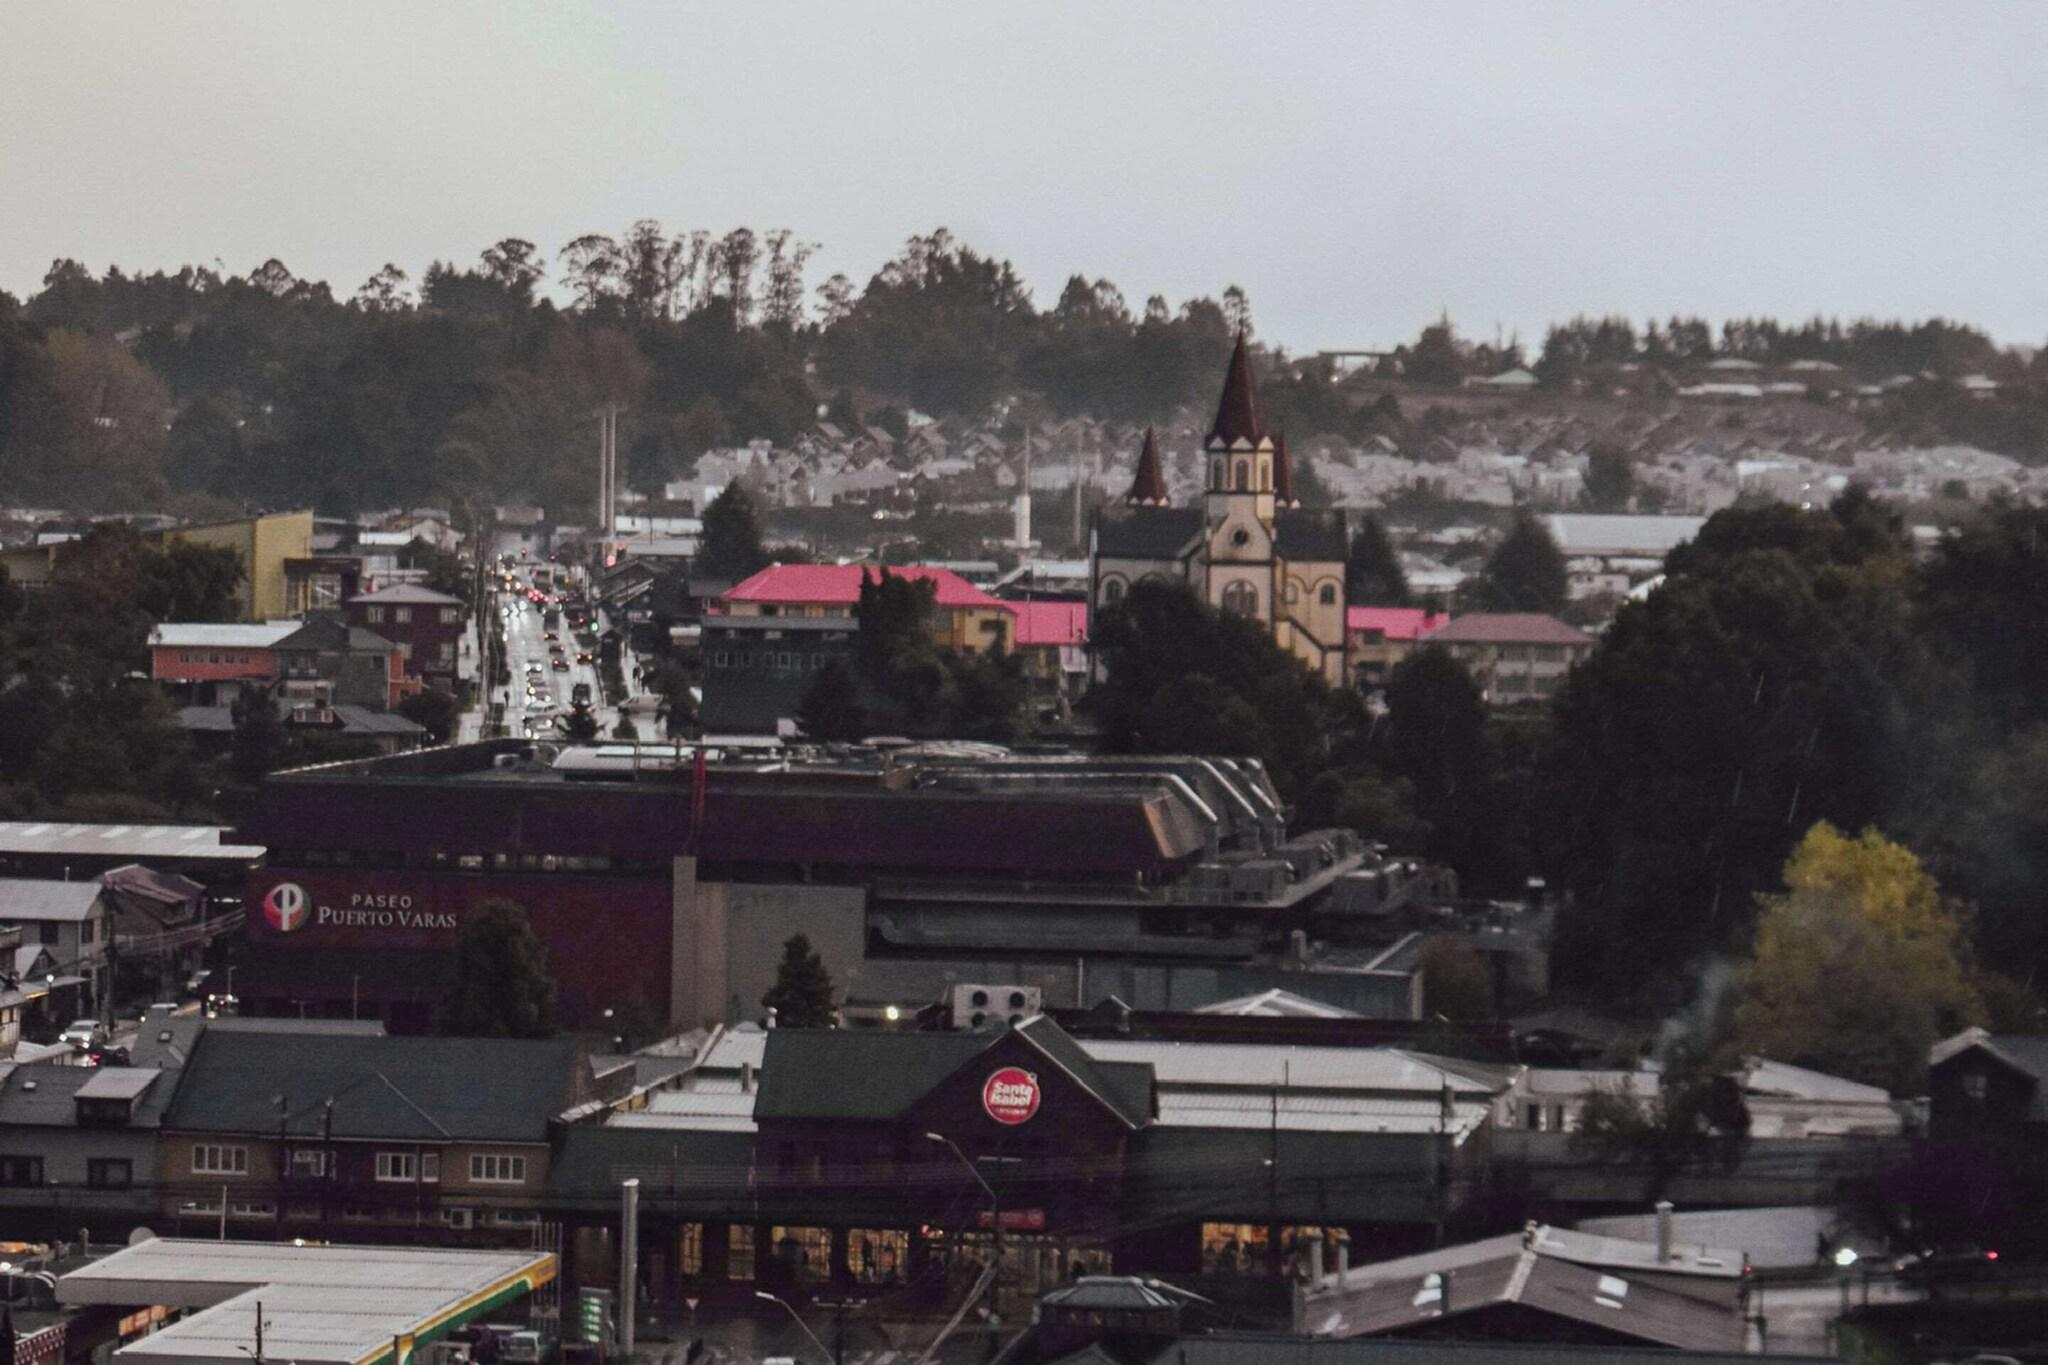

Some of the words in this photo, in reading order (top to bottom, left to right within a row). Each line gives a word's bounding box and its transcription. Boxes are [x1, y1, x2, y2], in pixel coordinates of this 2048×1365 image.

[352, 894, 412, 908] PASEO
[318, 906, 393, 925] PUERTO
[397, 910, 457, 928] VARAS
